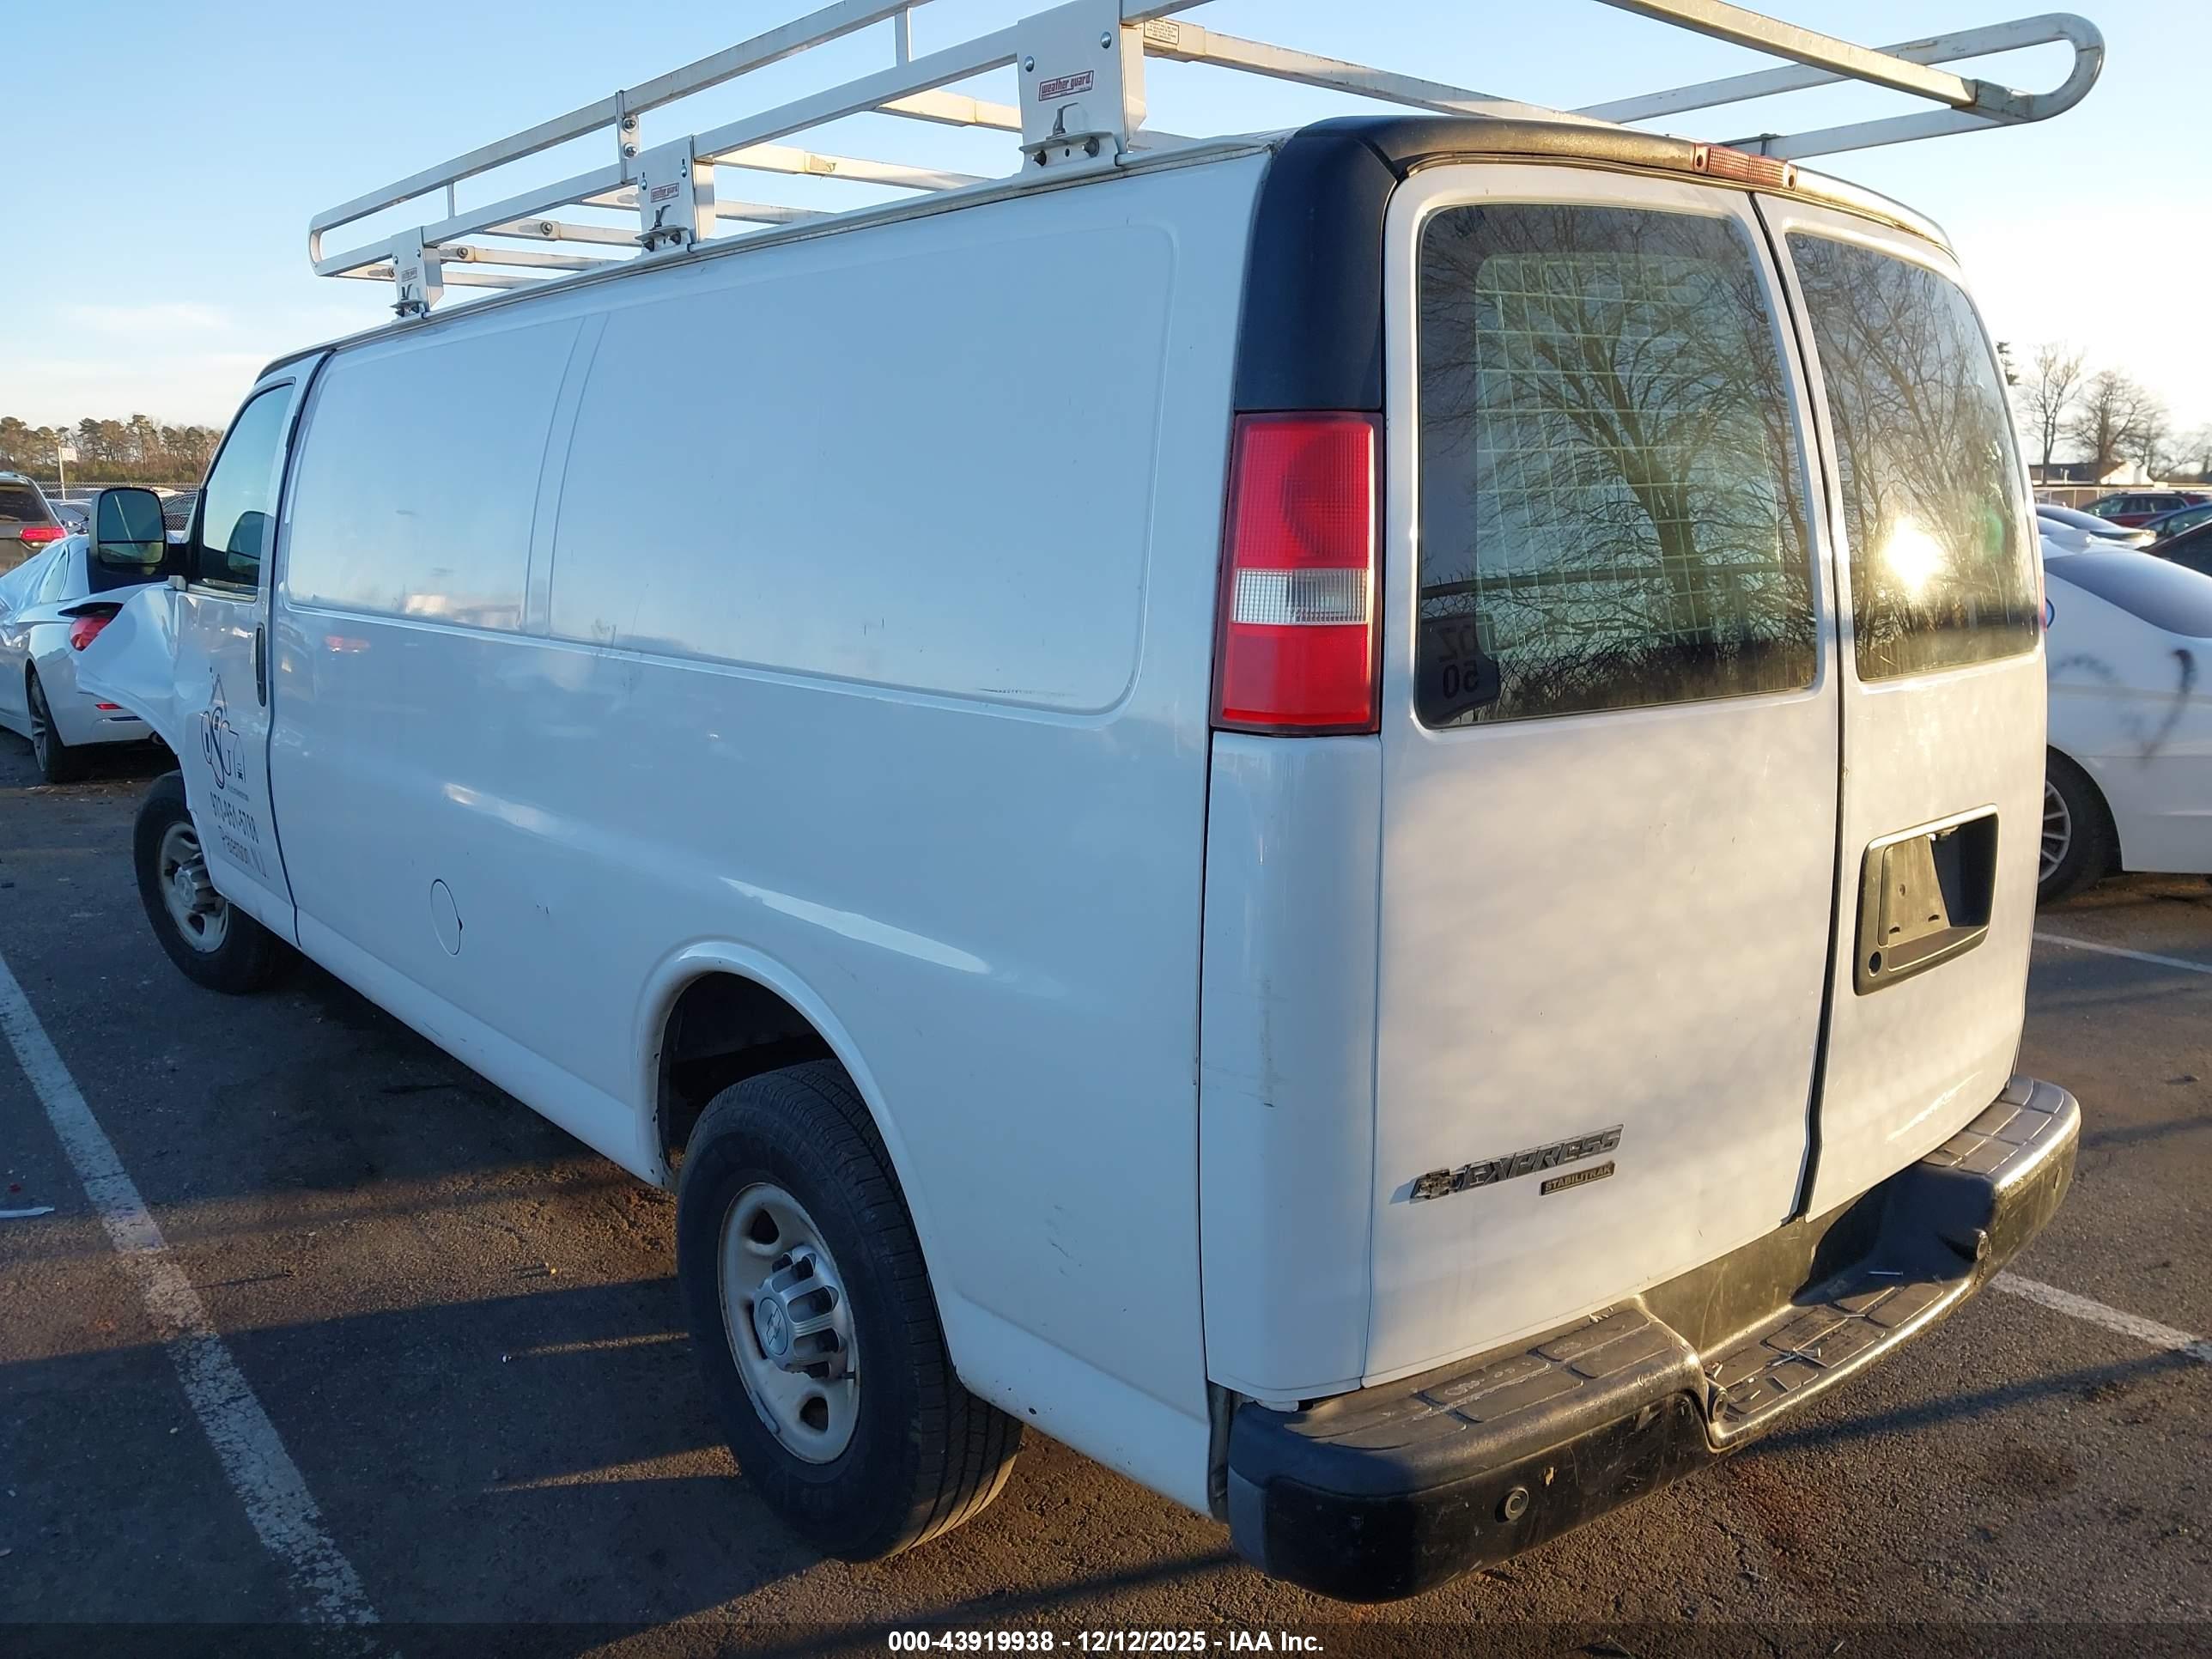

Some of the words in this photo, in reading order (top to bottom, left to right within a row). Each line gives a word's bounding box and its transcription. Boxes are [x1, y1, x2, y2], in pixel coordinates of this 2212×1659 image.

[1042, 78, 1069, 94] weather
[1071, 72, 1091, 90] guard
[1462, 1127, 1623, 1190] EXPRESS
[1544, 1164, 1613, 1193] STABILITRAK
